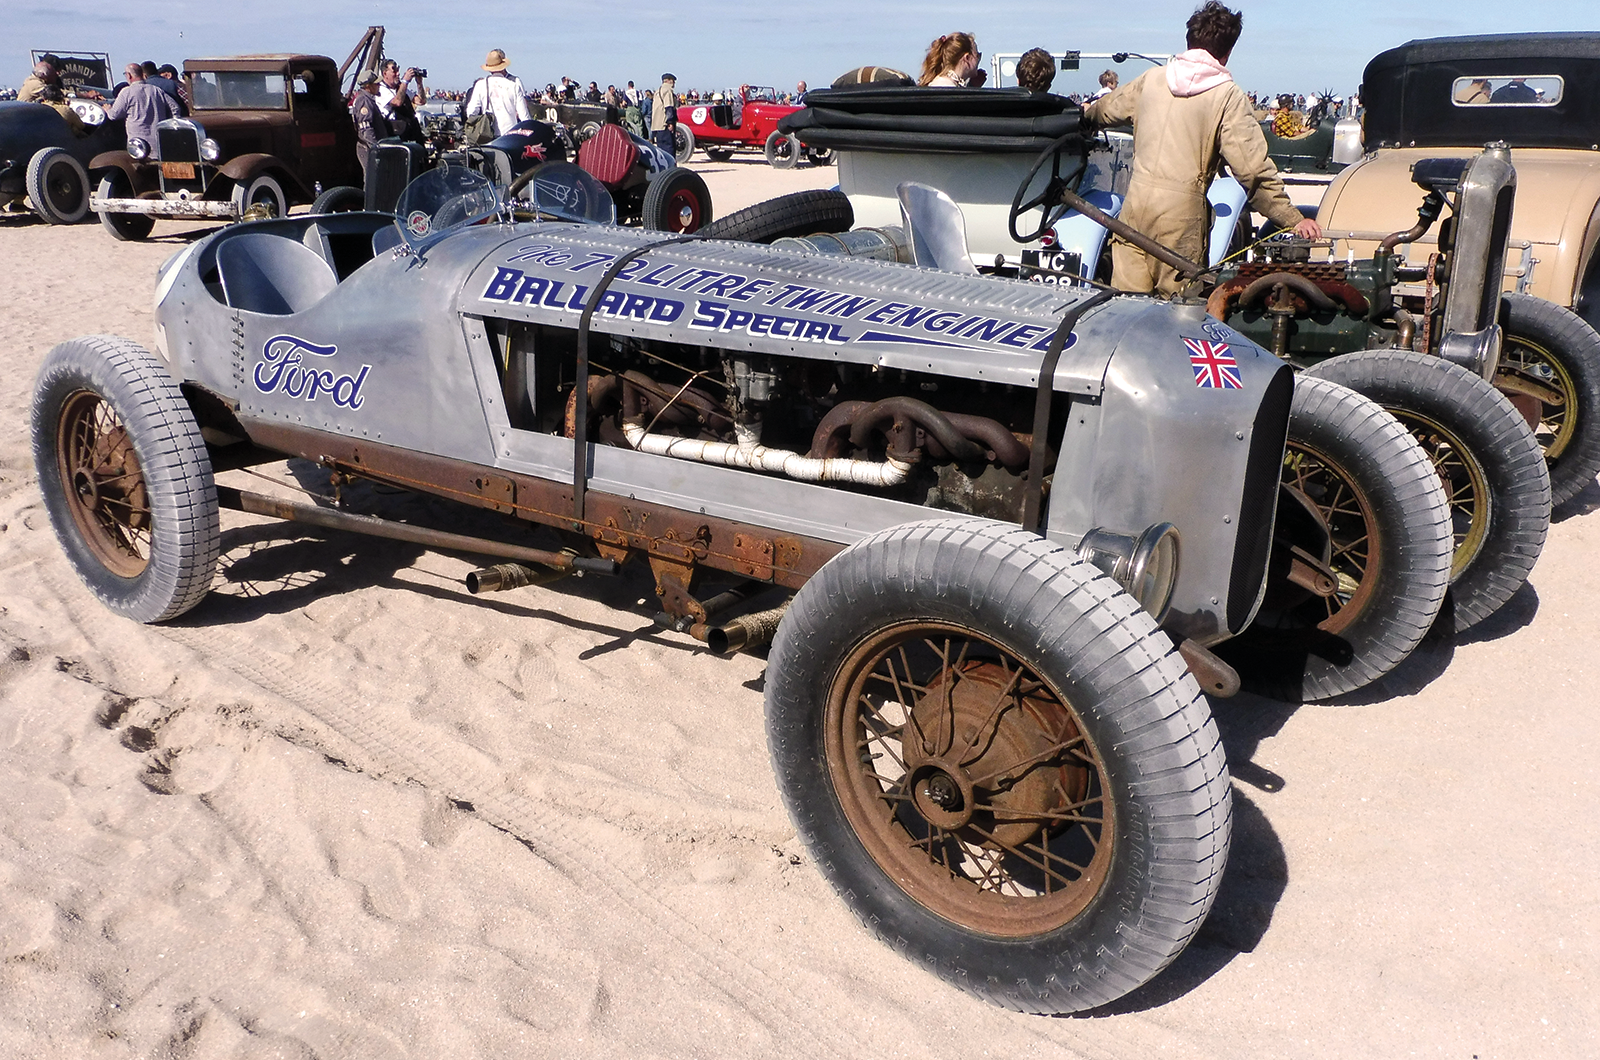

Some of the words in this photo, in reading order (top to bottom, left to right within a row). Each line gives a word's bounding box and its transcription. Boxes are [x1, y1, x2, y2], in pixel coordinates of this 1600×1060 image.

[545, 107, 558, 123] 19
[505, 244, 573, 268] The
[859, 301, 1079, 352] ENGINED
[1039, 251, 1066, 271] WC
[478, 265, 686, 326] BALLARD
[687, 298, 851, 346] SPECIAL
[253, 334, 372, 411] Ford
